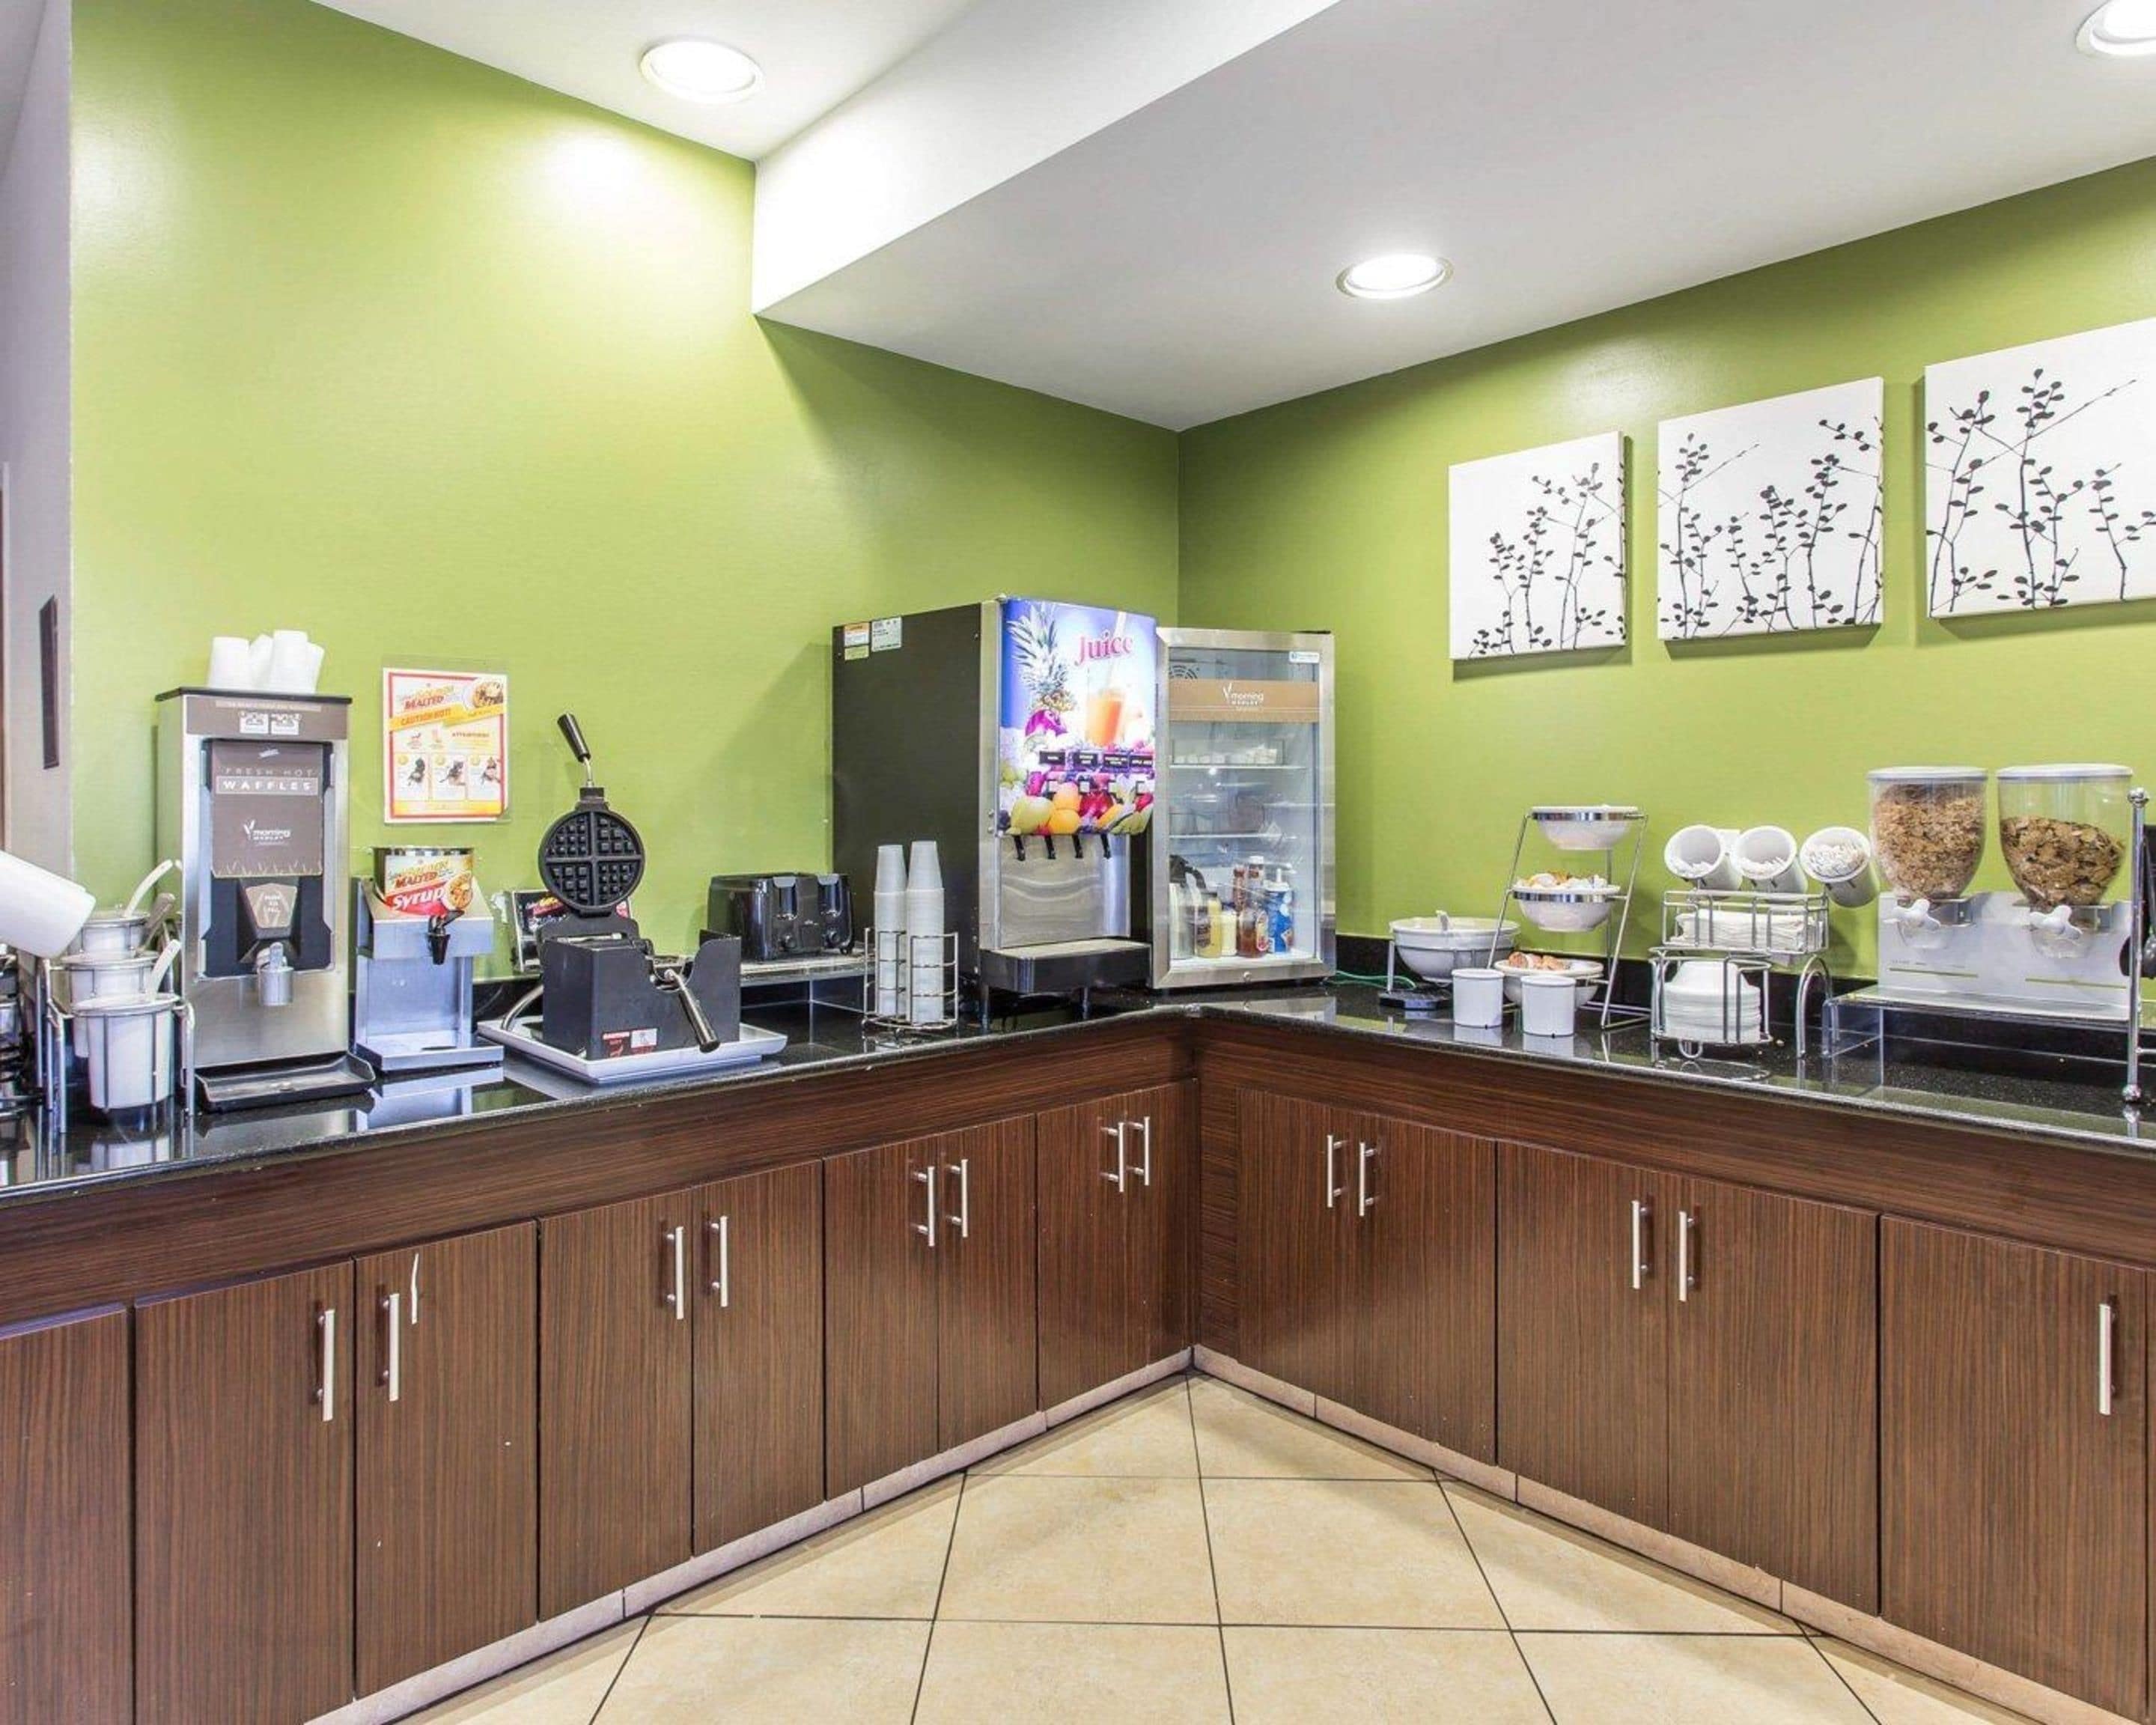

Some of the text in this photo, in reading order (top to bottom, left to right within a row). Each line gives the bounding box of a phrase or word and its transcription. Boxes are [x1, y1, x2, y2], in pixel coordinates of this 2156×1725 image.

[1074, 631, 1133, 666] Juice
[225, 767, 316, 777] FRESH HOT
[222, 780, 312, 791] WAFFLES
[392, 886, 445, 910] Syrup
